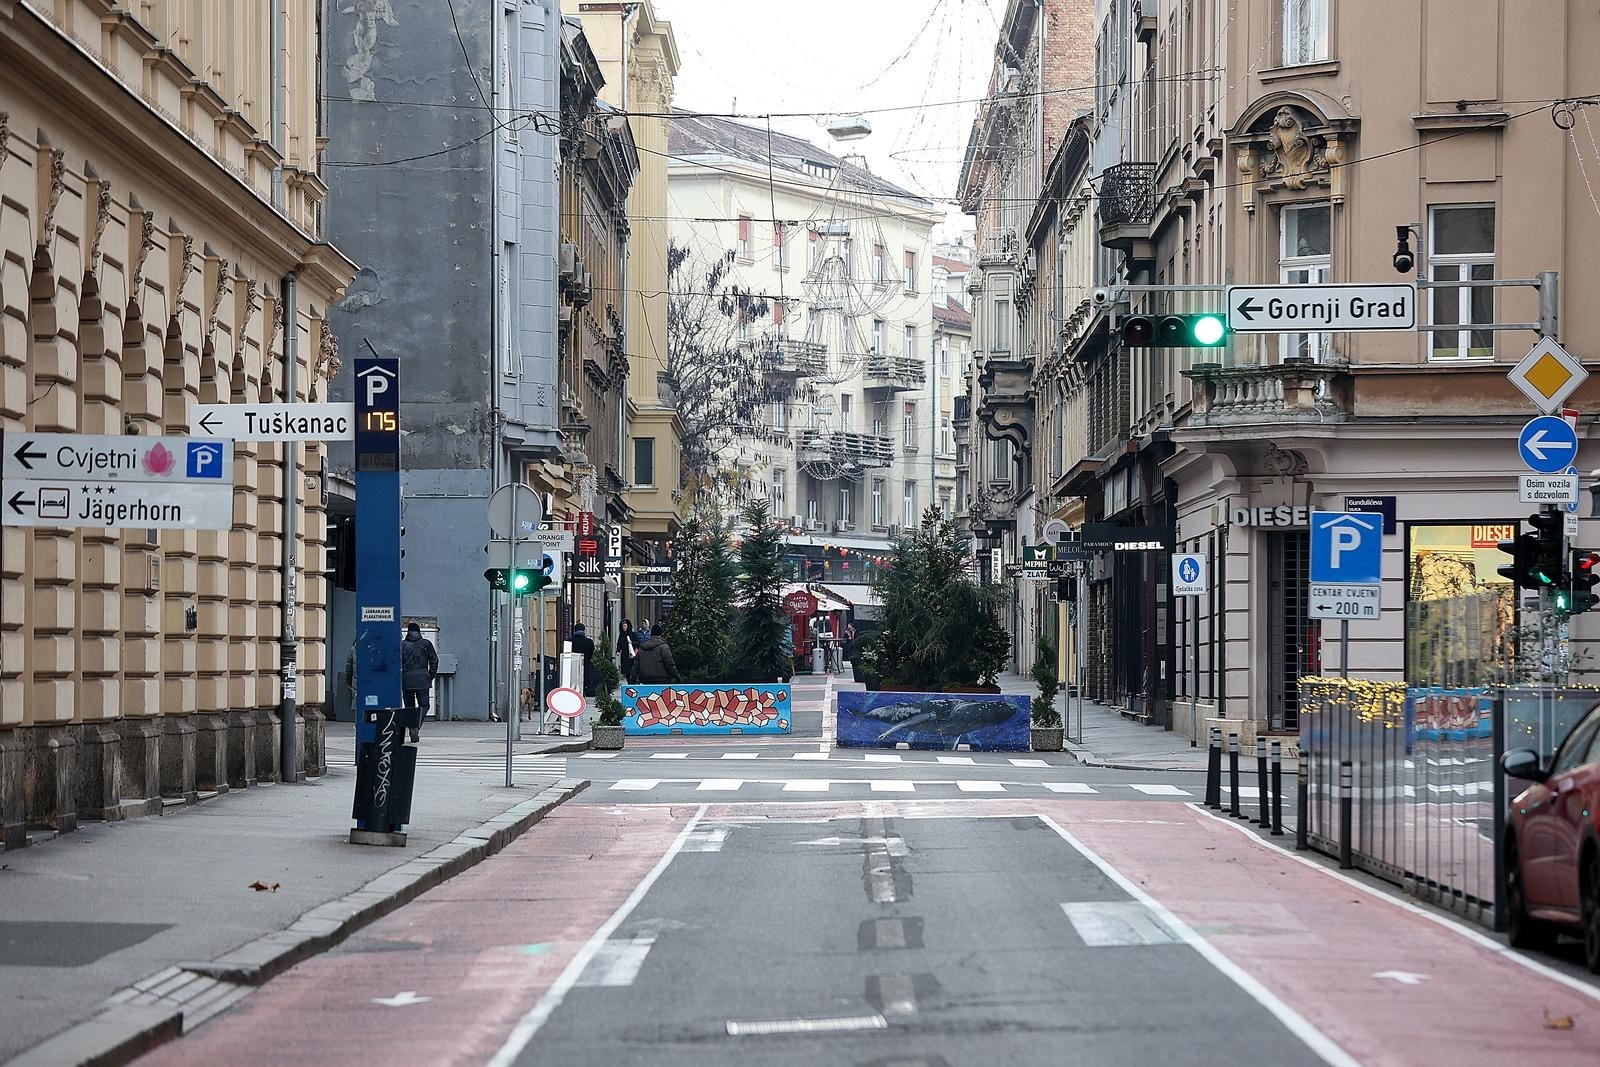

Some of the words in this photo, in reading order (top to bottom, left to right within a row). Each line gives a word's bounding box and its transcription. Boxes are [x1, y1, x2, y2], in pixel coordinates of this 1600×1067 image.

[1268, 297, 1340, 324] Gornji
[1349, 297, 1406, 319] Grad
[367, 376, 389, 406] P
[244, 411, 347, 434] Tuškanac
[367, 411, 396, 431] 175
[56, 446, 137, 474] Cvjetni
[197, 454, 213, 474] P
[1526, 479, 1545, 488] Osim
[1548, 479, 1571, 488] vozila
[1534, 490, 1570, 499] dozvolom
[79, 497, 182, 525] Jägerhorn
[1114, 541, 1165, 551] DIESEL
[1330, 526, 1362, 569] P
[578, 557, 601, 573] silk
[1312, 587, 1343, 598] CENTAR
[1345, 587, 1378, 597] CVJETNI
[1335, 602, 1359, 615] 200
[1363, 604, 1375, 615] m
